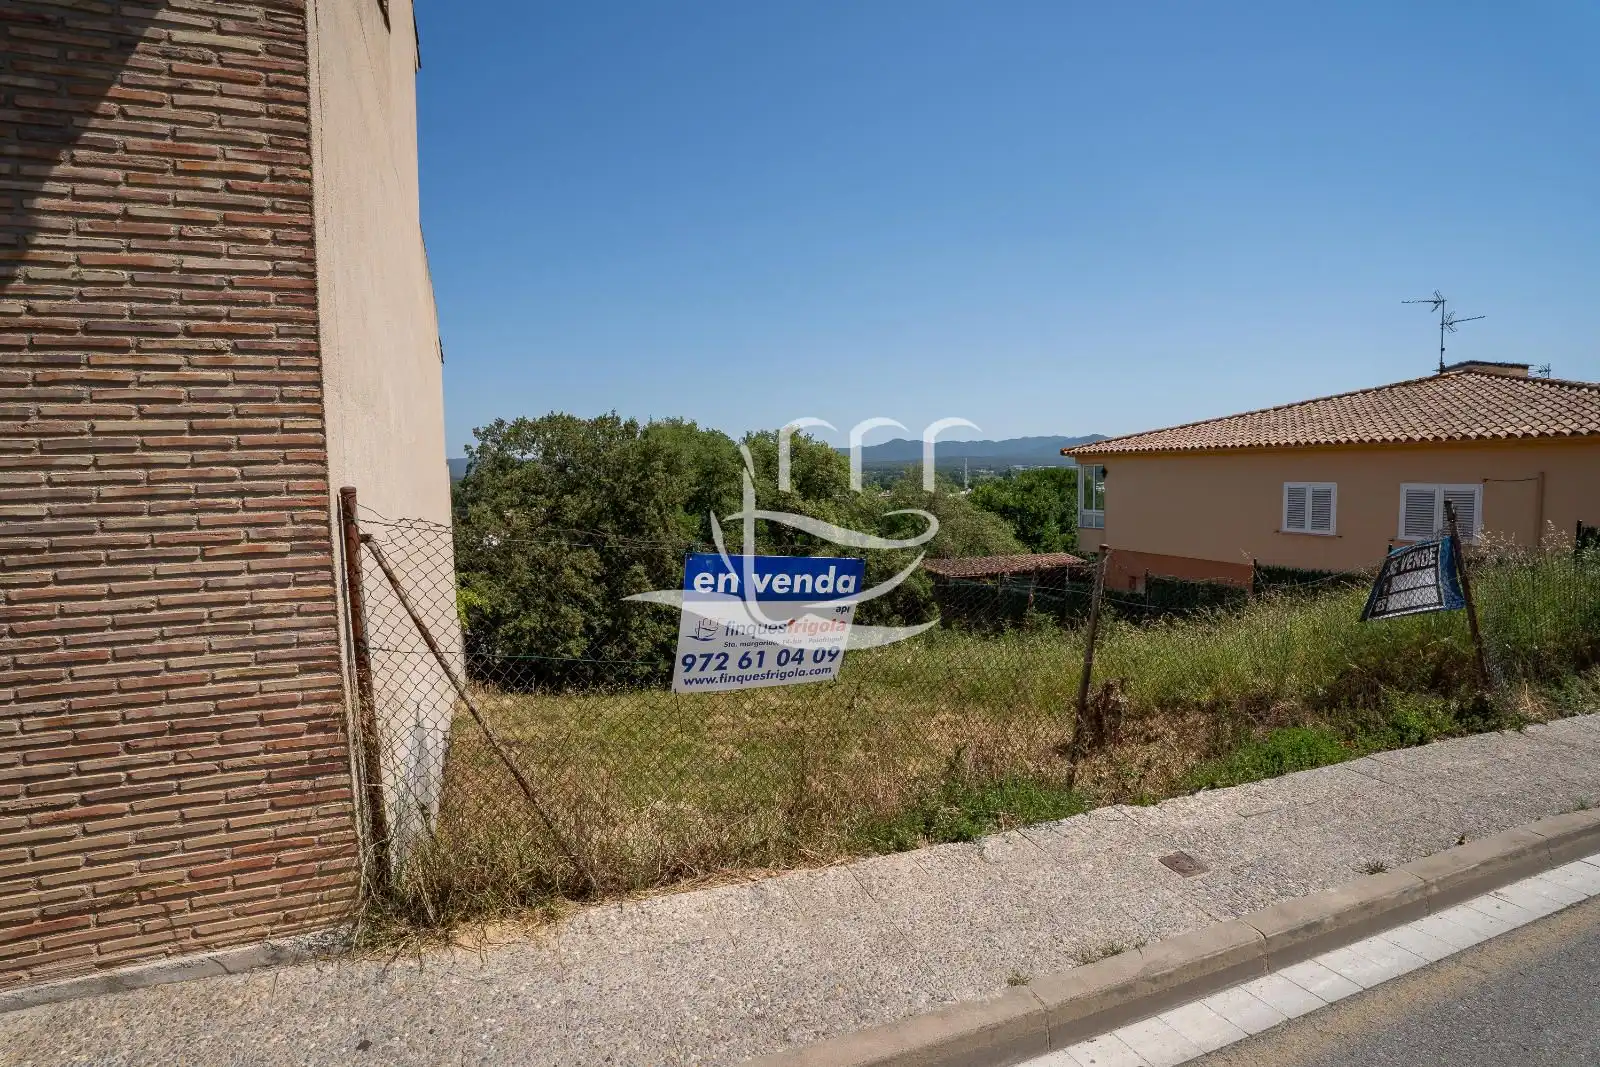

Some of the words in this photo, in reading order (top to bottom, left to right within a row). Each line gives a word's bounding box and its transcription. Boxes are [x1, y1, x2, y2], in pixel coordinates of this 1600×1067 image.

[1401, 547, 1438, 571] VENDE
[693, 572, 739, 594] en
[751, 565, 856, 594] venda
[725, 618, 847, 639] finquesfrigola
[682, 652, 729, 673] 972
[737, 650, 766, 670] 61
[776, 648, 805, 666] 04
[812, 646, 841, 664] 09
[683, 665, 832, 686] www.finquesfrigola.com
